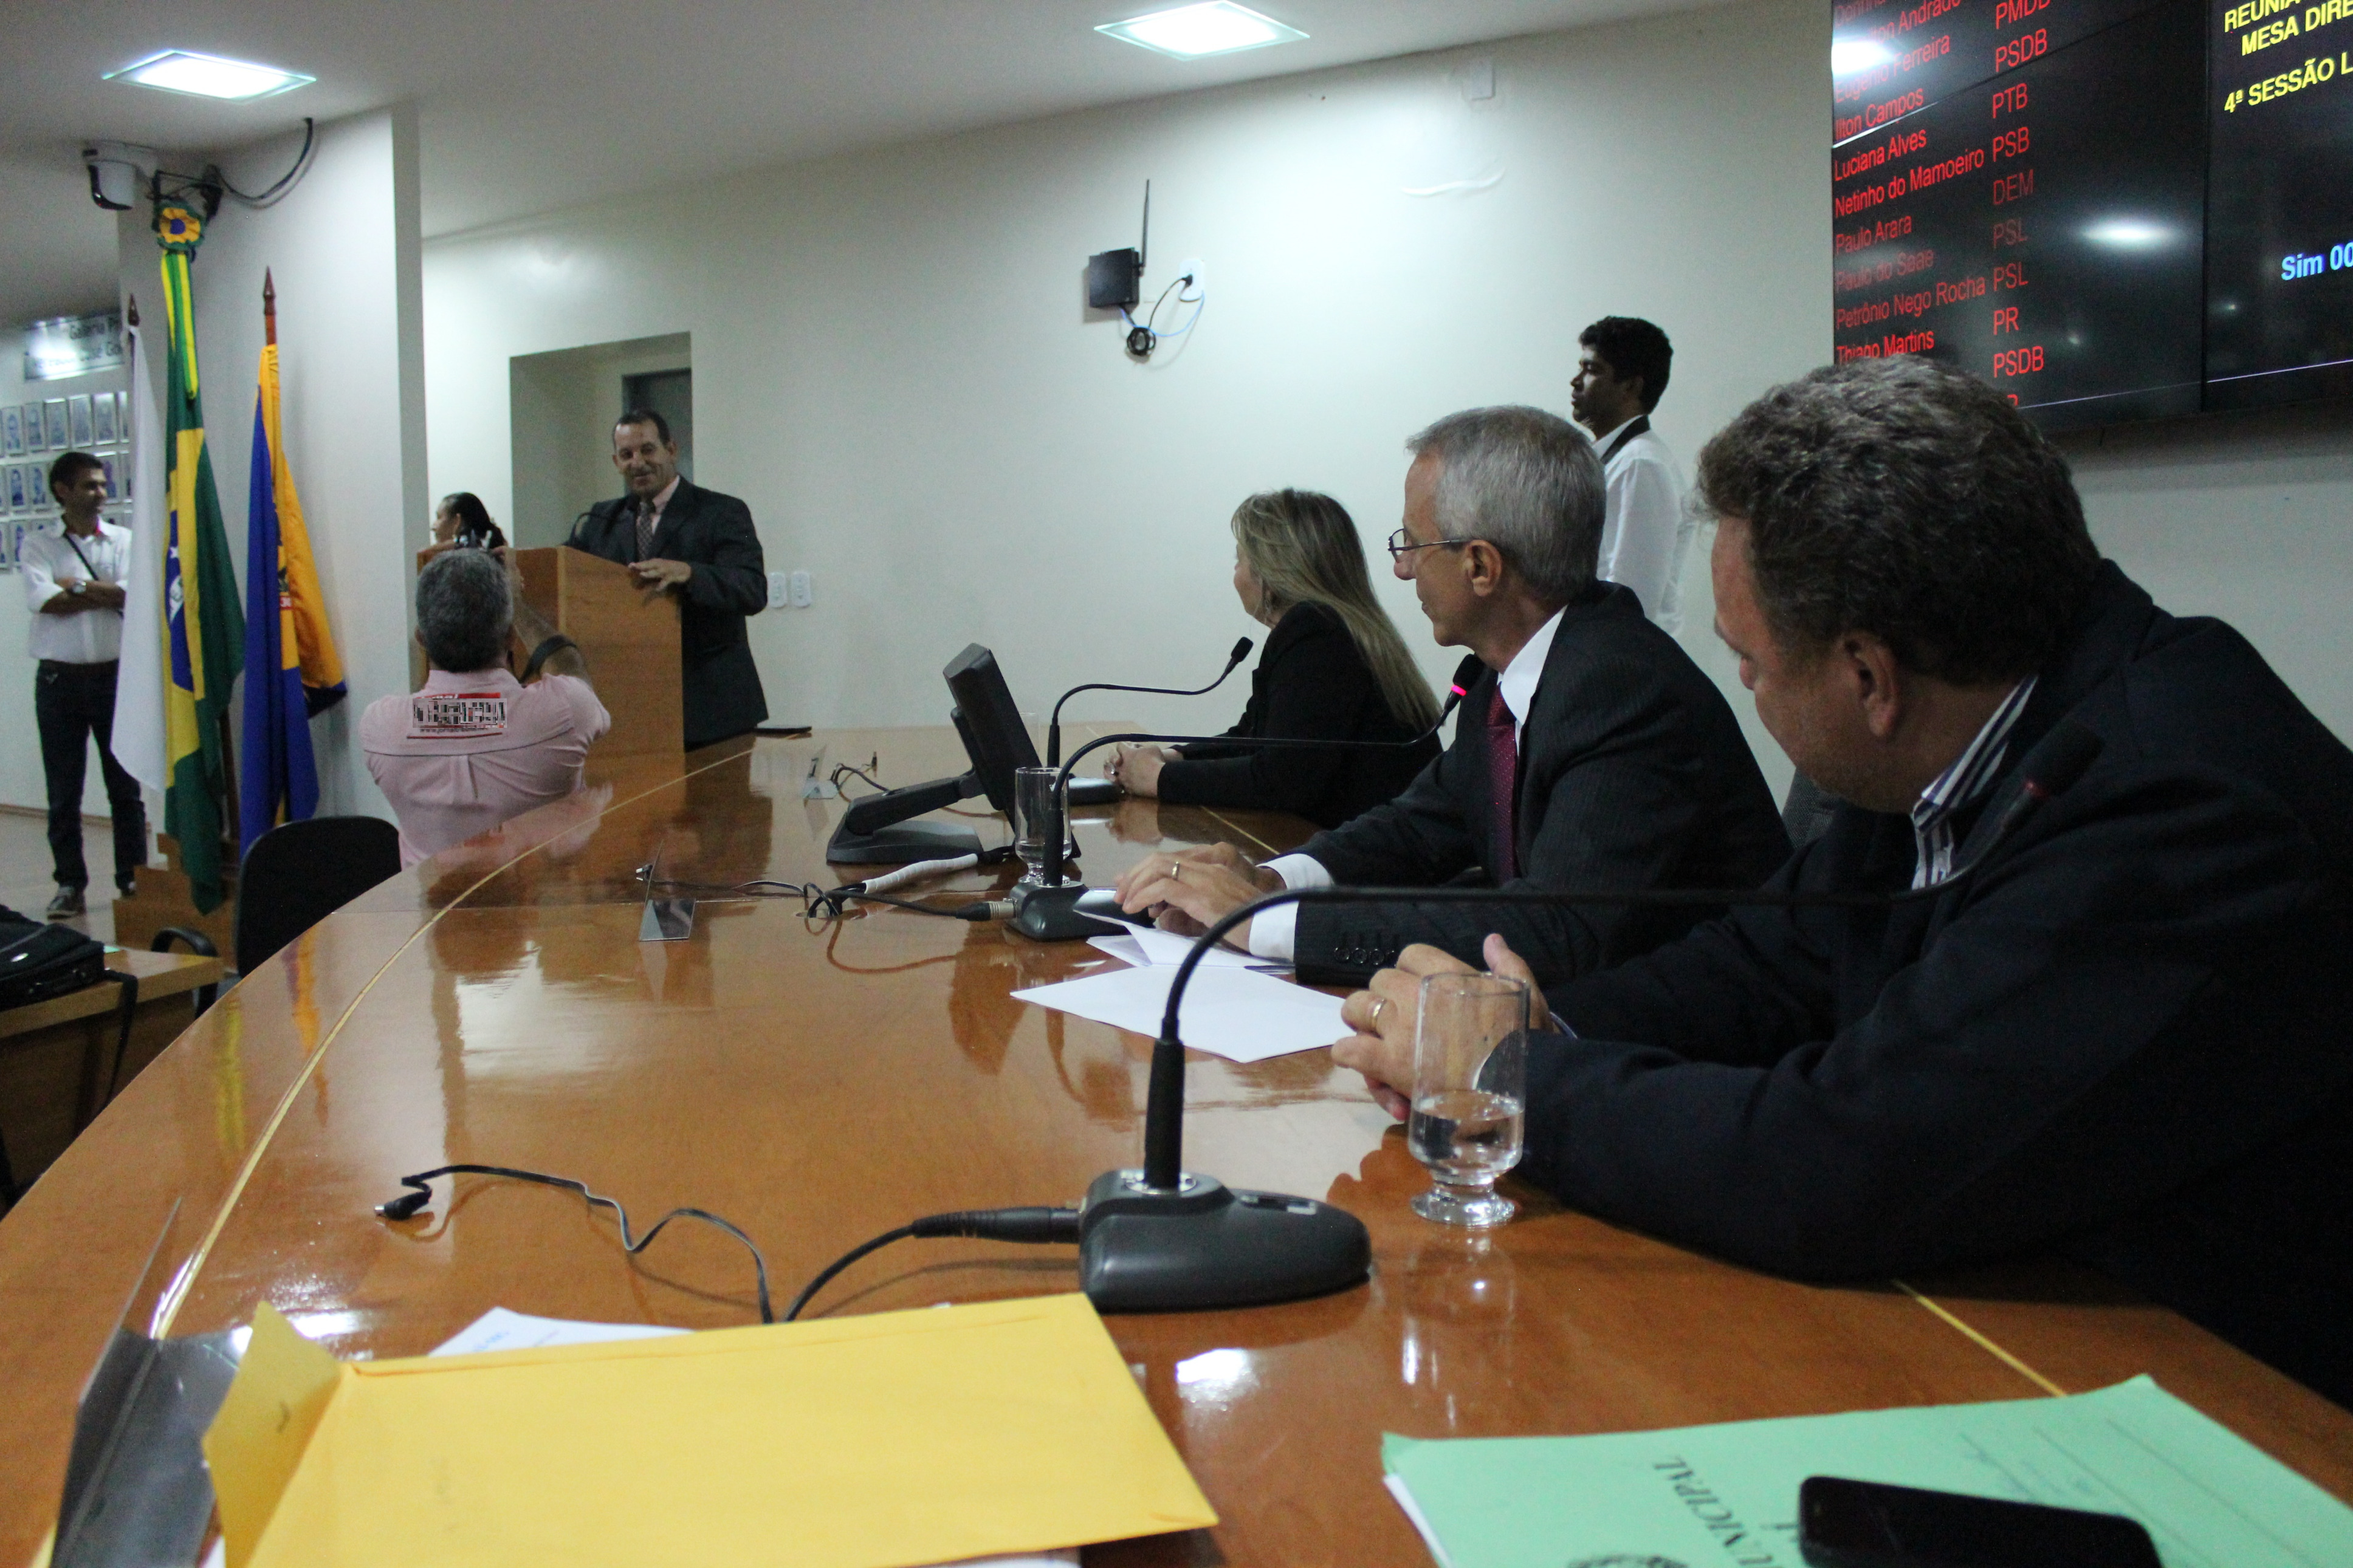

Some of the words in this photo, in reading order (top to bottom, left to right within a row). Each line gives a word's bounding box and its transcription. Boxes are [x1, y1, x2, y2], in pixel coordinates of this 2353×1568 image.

[1894, 35, 1950, 77] Ferreira
[2242, 16, 2299, 56] MESA
[1866, 88, 1924, 127] Campos
[1996, 28, 2047, 72] PSDB
[2248, 58, 2335, 106] SESSÃO
[1835, 146, 1885, 181] Luciana
[1888, 129, 1927, 160] Alves
[1993, 83, 2028, 118] PTB
[1835, 185, 1884, 217] Netinho
[1888, 176, 1906, 199] do
[1909, 148, 1985, 191] Mamoeiro
[1993, 126, 2030, 162] PSB
[1836, 227, 1872, 254] Paulo
[1875, 216, 1912, 243] Arara
[1993, 169, 2033, 205] DEM
[1993, 218, 2028, 248] PSL
[2281, 253, 2323, 281] Sim
[1836, 302, 1890, 330] Petrônio
[1894, 291, 1932, 317] Nego
[1936, 276, 1986, 306] Rocha
[1993, 261, 2028, 292] PSL
[1884, 329, 1935, 358] Martins
[1993, 307, 2019, 335] PR
[1993, 346, 2044, 378] PSDB
